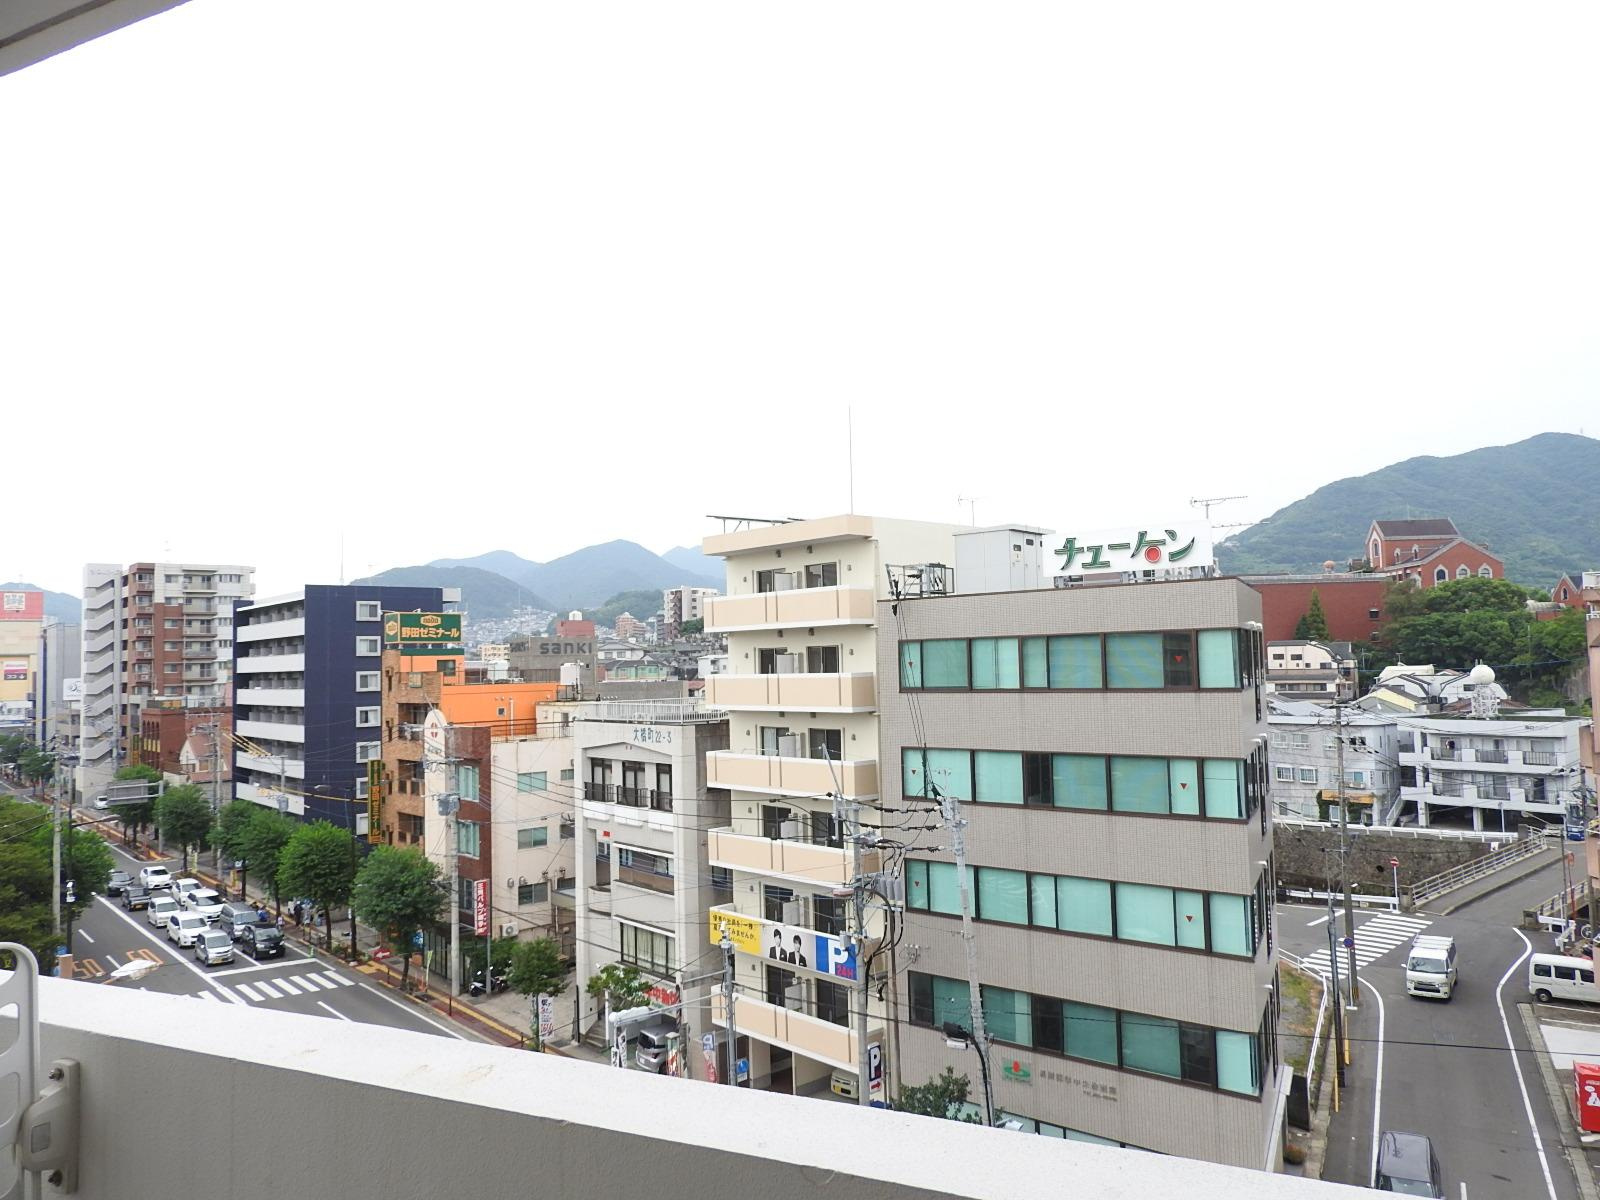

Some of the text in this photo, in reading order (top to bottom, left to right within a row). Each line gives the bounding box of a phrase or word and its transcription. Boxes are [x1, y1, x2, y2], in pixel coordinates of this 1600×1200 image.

[401, 627, 460, 638] 野田ゼミナール
[539, 642, 592, 655] sanki
[828, 939, 849, 975] P
[870, 1046, 881, 1079] P
